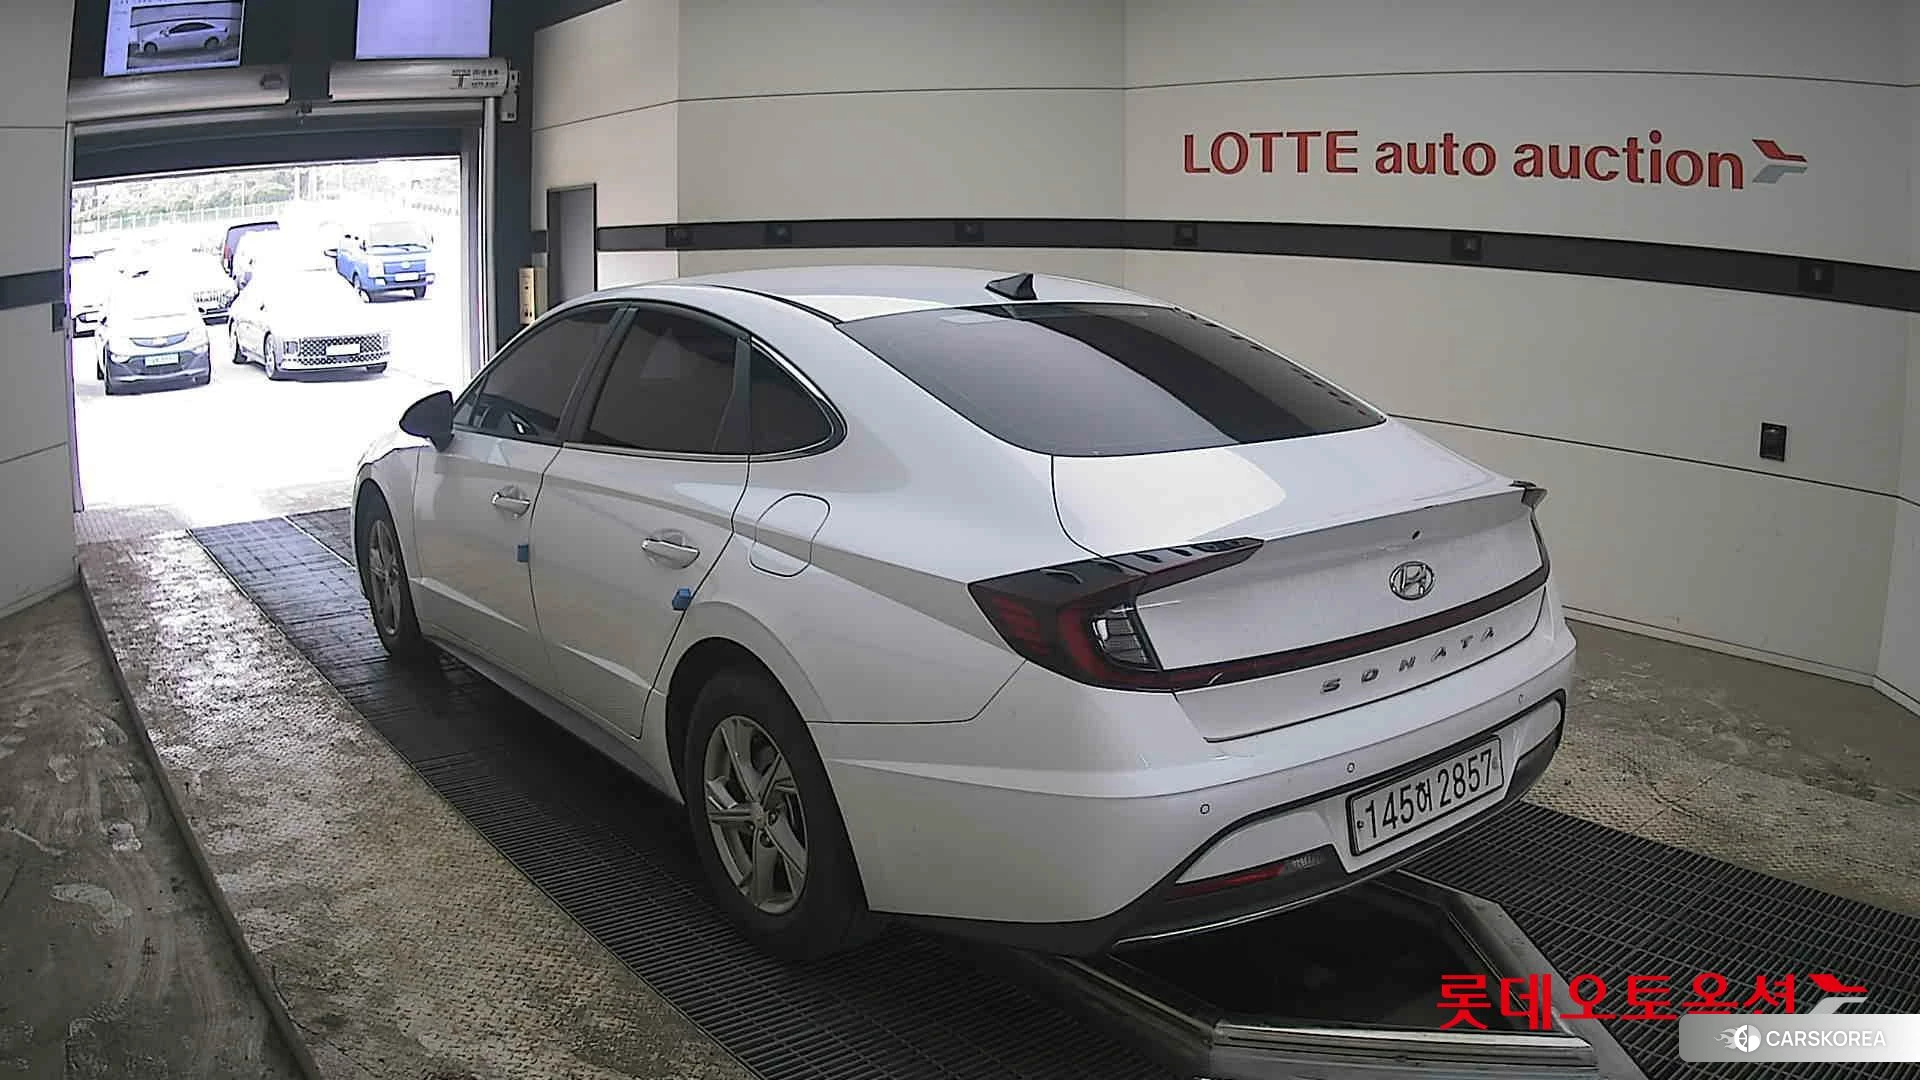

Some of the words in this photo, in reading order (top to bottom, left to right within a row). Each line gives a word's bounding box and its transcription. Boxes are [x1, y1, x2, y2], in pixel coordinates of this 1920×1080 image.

[1183, 130, 1359, 175] LOTTE
[1375, 131, 1496, 177] auto
[1513, 129, 1744, 190] auction
[1320, 625, 1496, 695] SONATA
[1364, 778, 1433, 840] 145허
[1437, 748, 1493, 809] 2857
